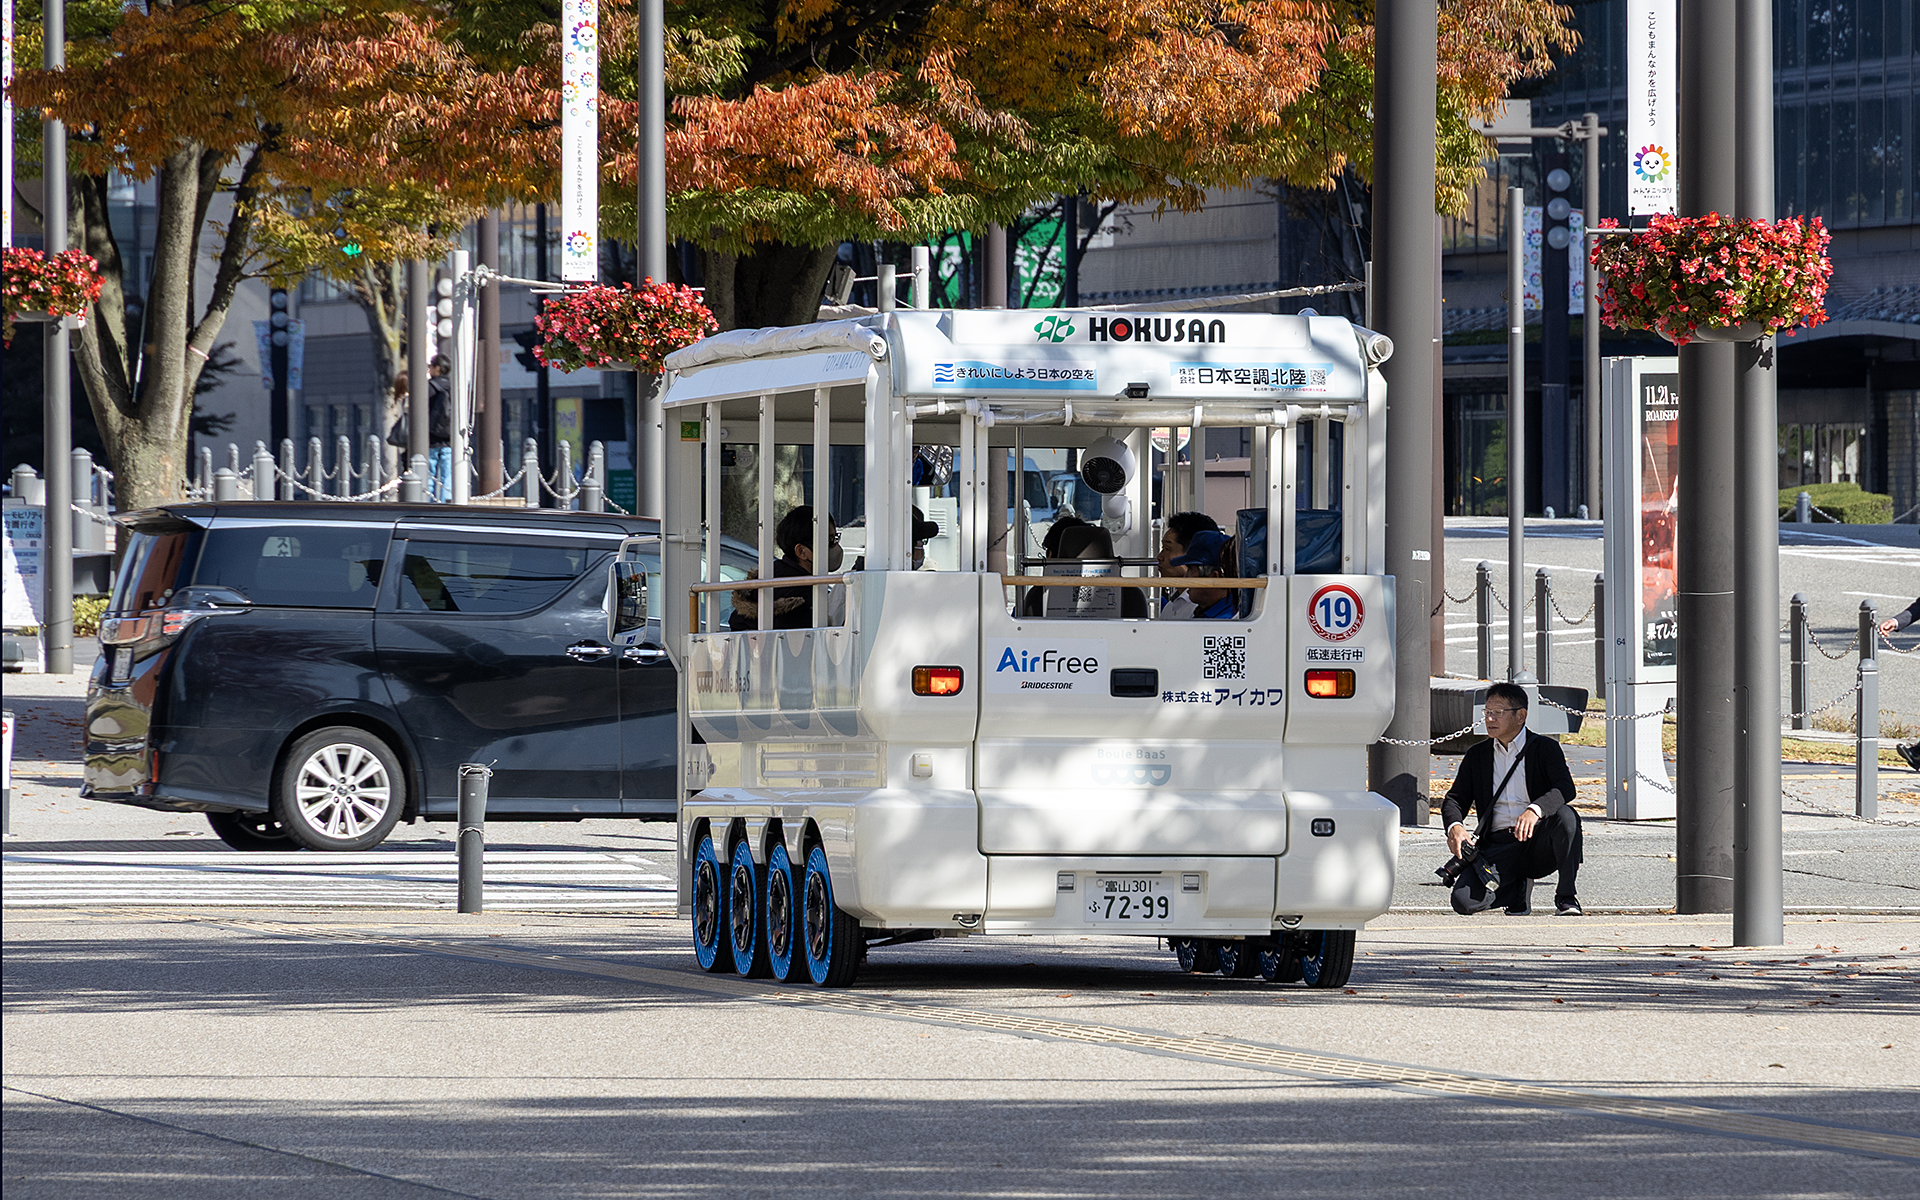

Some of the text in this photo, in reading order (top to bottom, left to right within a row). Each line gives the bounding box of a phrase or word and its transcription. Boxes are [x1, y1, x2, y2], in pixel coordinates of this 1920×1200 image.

[1647, 11, 1657, 127] こどもまんなかを広げよう
[1089, 317, 1226, 343] HOKUSAN
[956, 368, 1095, 380] きれいにしよう日本の空を
[1198, 368, 1307, 385] 日本空調北陸
[1645, 385, 1669, 405] 11.21
[1319, 597, 1352, 628] 19
[1616, 637, 1626, 645] 64
[996, 647, 1099, 673] AirFree
[1307, 648, 1363, 660] 低速走行中
[716, 670, 750, 693] Boule BaaS
[1021, 681, 1074, 690] BRIDGESTONE
[1161, 688, 1283, 706] 株式会社アイカワ
[1097, 749, 1166, 760] Boule BaaS
[1088, 895, 1169, 919] ふ 72-99
